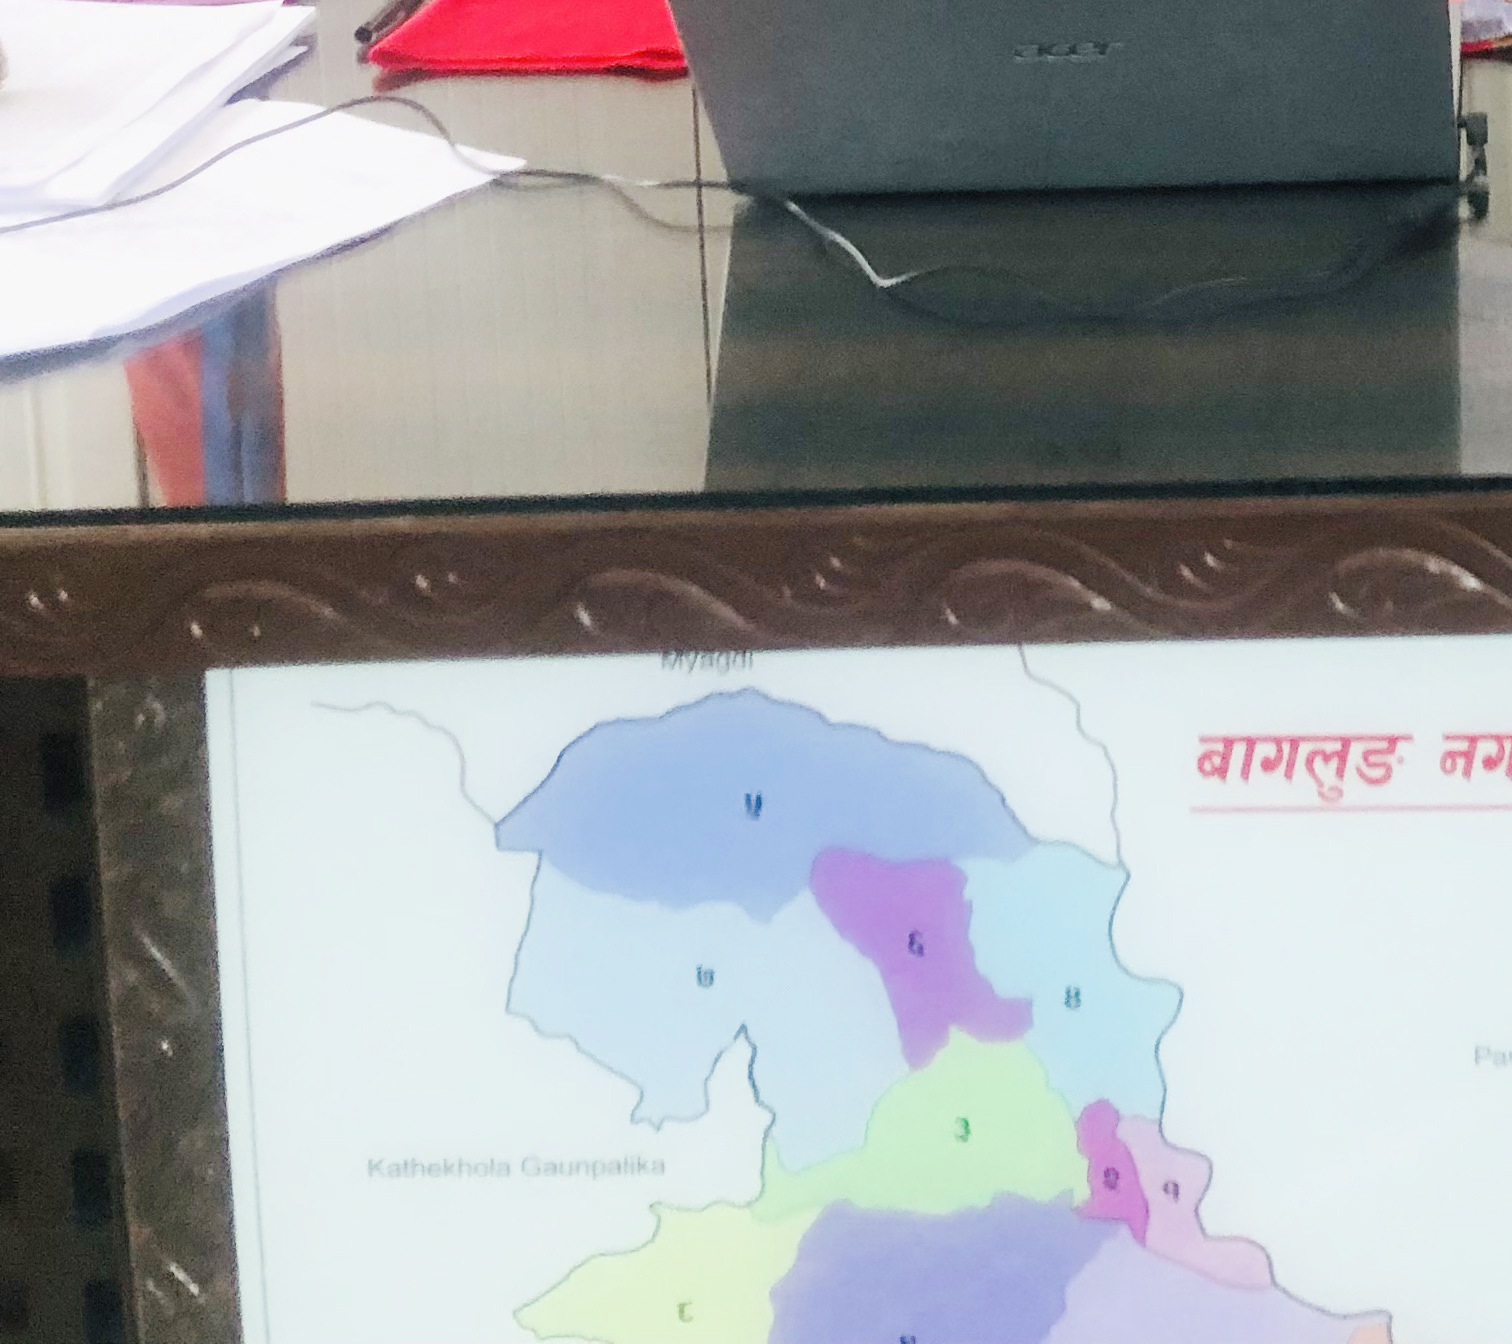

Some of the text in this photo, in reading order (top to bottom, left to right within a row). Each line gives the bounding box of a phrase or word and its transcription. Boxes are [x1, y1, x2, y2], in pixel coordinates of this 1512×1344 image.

[1197, 733, 1414, 805] बागलुङ
[367, 1155, 666, 1181] Kathekhola Gaunpalika
